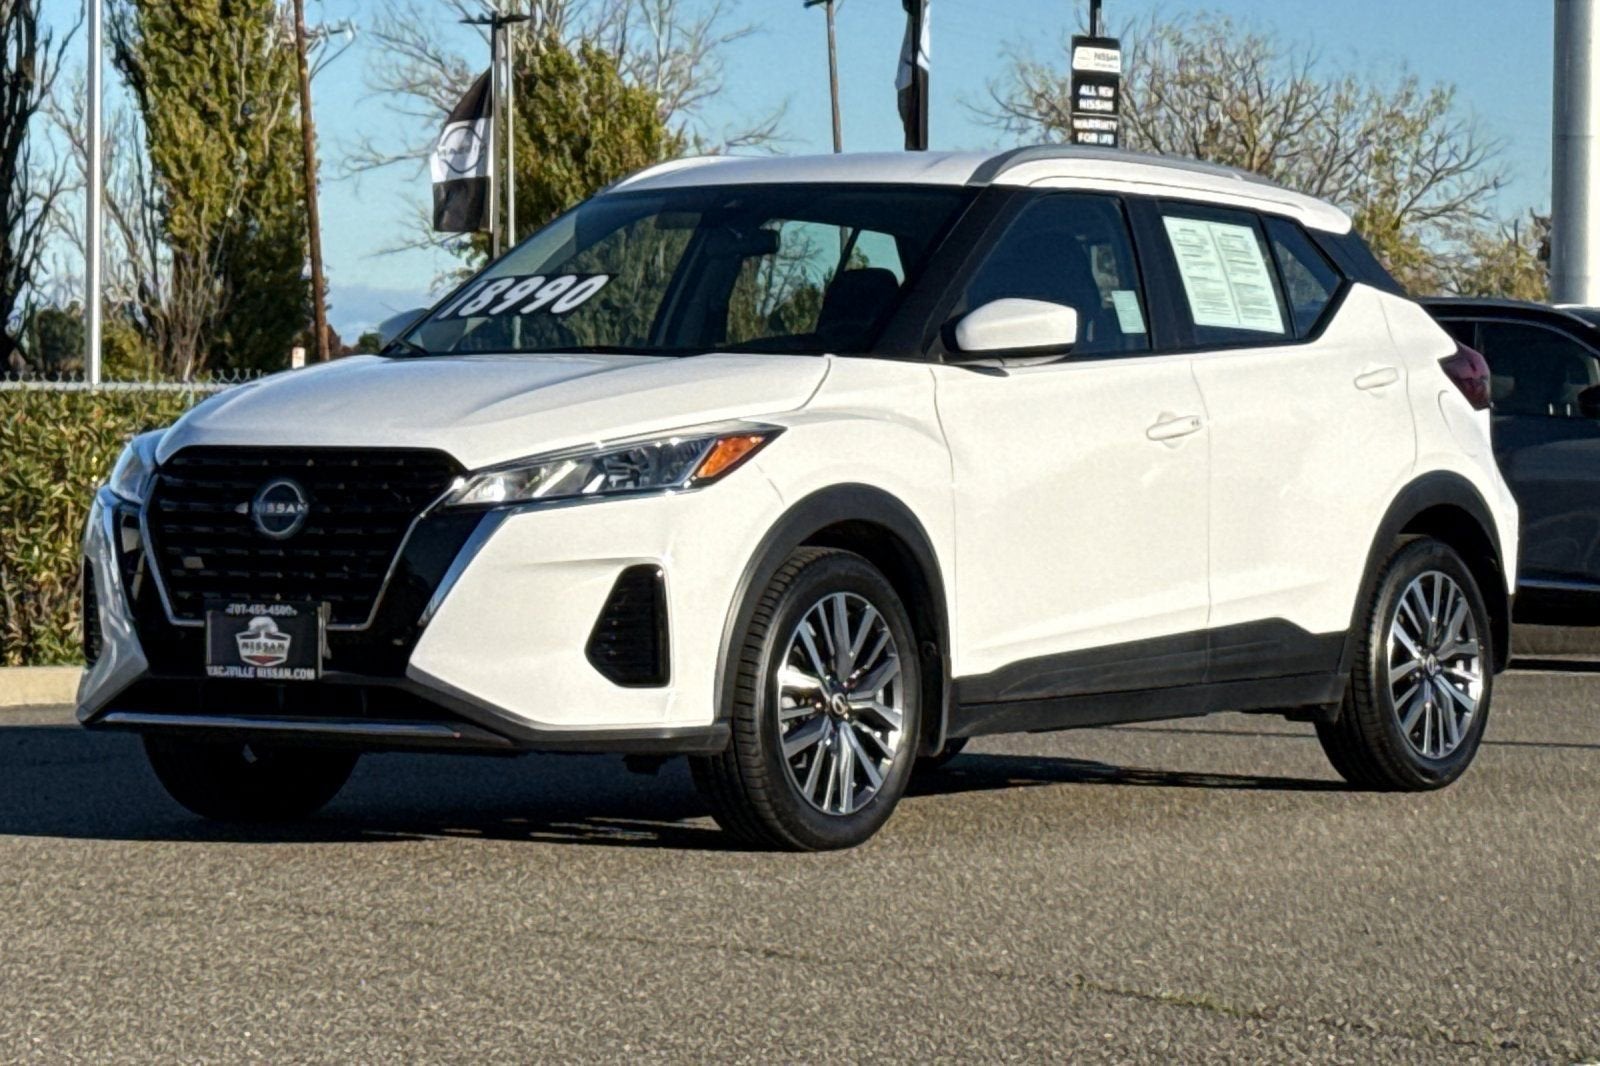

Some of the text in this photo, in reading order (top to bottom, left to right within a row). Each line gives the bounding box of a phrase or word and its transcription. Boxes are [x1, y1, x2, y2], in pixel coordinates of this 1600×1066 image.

[1079, 85, 1096, 96] ALL
[1079, 98, 1113, 111] NISSAN
[1078, 132, 1098, 143] FOR
[438, 274, 609, 320] 18990
[252, 502, 309, 514] NISSAN
[241, 641, 285, 654] NISSAN
[206, 665, 315, 680] VACAVILLE NISSAN.COM
